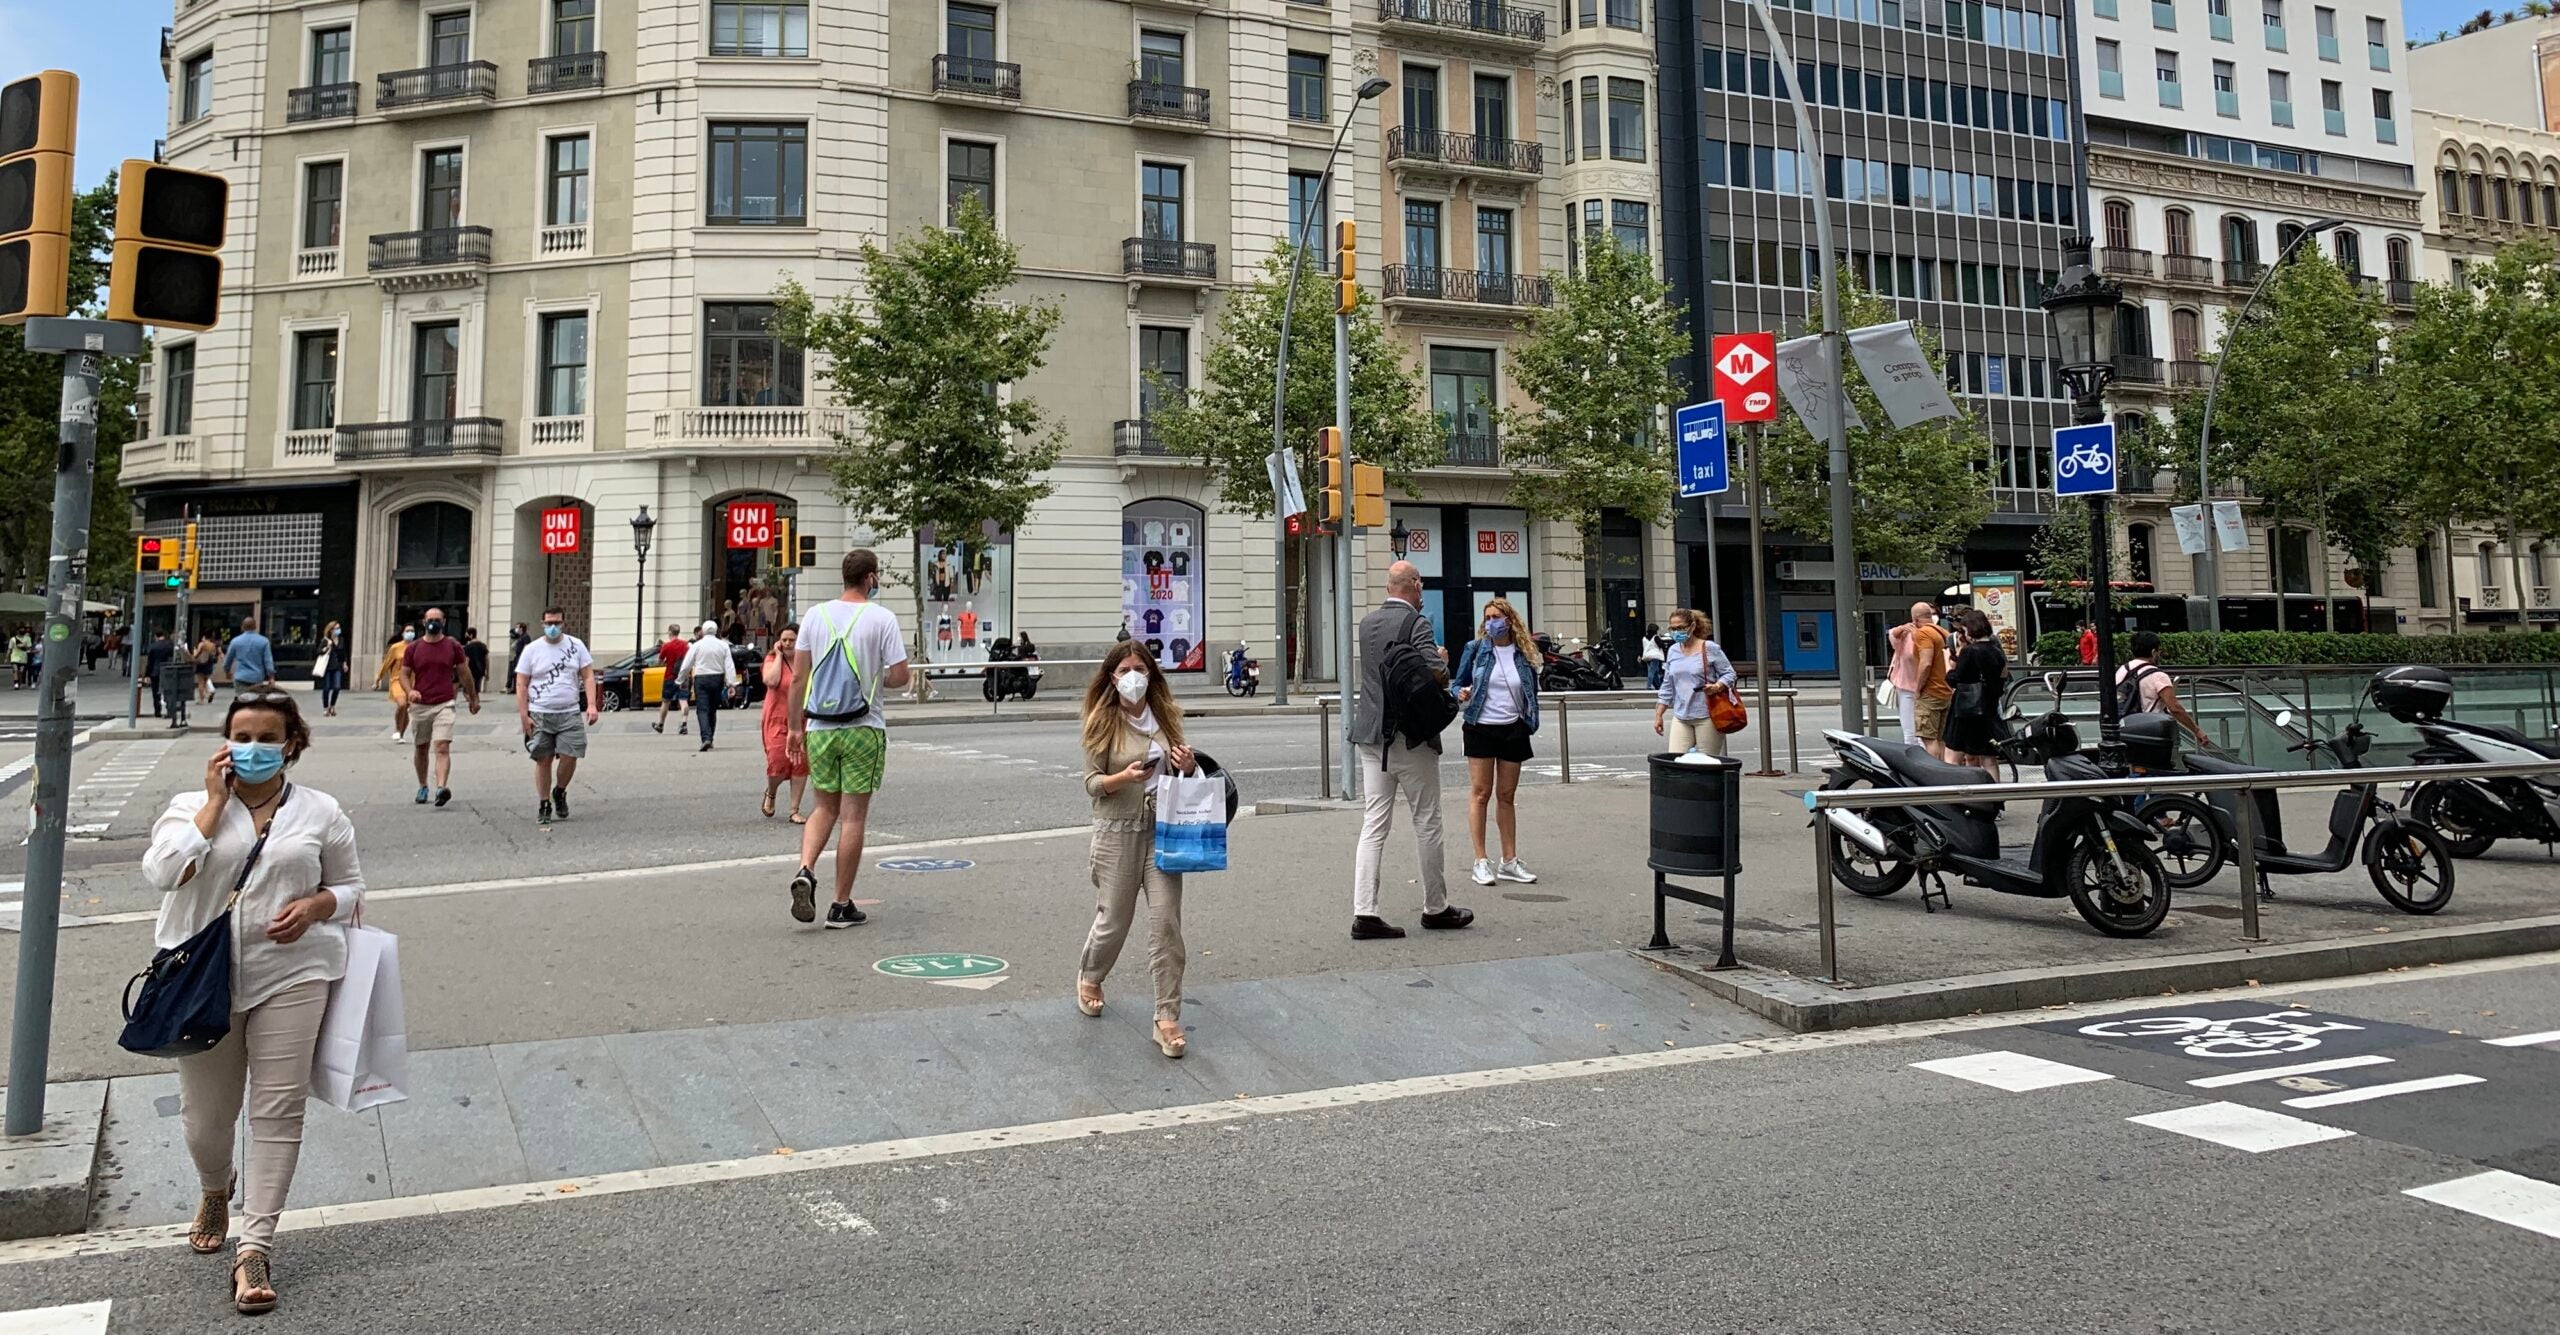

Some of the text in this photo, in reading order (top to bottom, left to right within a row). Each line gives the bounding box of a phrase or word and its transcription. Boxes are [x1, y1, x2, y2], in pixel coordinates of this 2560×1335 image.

[1730, 353, 1754, 375] M
[1883, 361, 1921, 374] Compra
[1893, 374, 1901, 382] a
[1748, 399, 1767, 407] TMB
[1693, 462, 1714, 480] taxi
[546, 513, 574, 530] UNI
[733, 508, 767, 525] UNI
[546, 531, 576, 550] QLO
[733, 526, 769, 546] QLO
[1479, 533, 1494, 542] UNI
[1480, 543, 1495, 552] QLO
[1150, 570, 1173, 590] UT
[1150, 590, 1174, 600] 2020
[890, 957, 999, 973] V15
